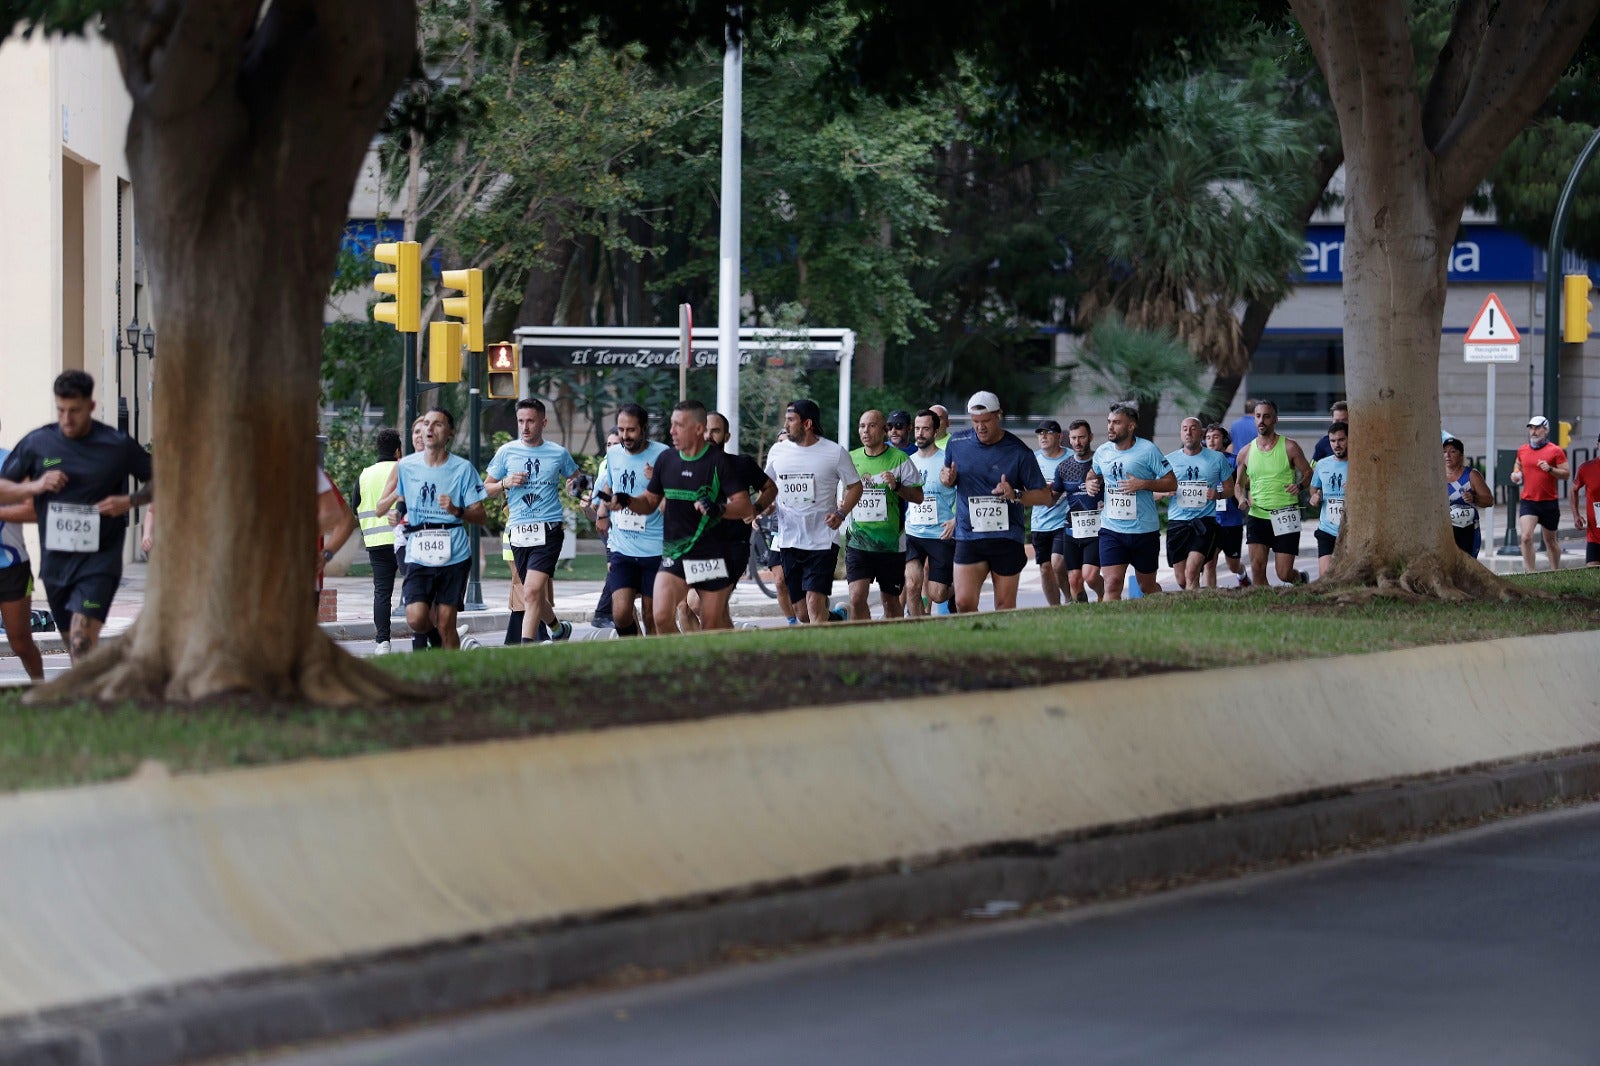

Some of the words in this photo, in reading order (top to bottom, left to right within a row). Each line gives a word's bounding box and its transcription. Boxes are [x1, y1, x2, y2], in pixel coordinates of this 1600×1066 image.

[571, 349, 592, 365] El
[593, 349, 664, 368] TerraZeo
[784, 483, 808, 493] 3009
[1182, 489, 1203, 497] 6204
[857, 499, 880, 508] 6937
[1110, 498, 1132, 507] 1730
[975, 507, 1002, 517] 6725
[1077, 518, 1096, 527] 1858
[1277, 513, 1297, 524] 1519
[56, 519, 91, 533] 6625
[516, 523, 539, 534] 1649
[418, 540, 444, 551] 1848
[690, 560, 720, 575] 6392
